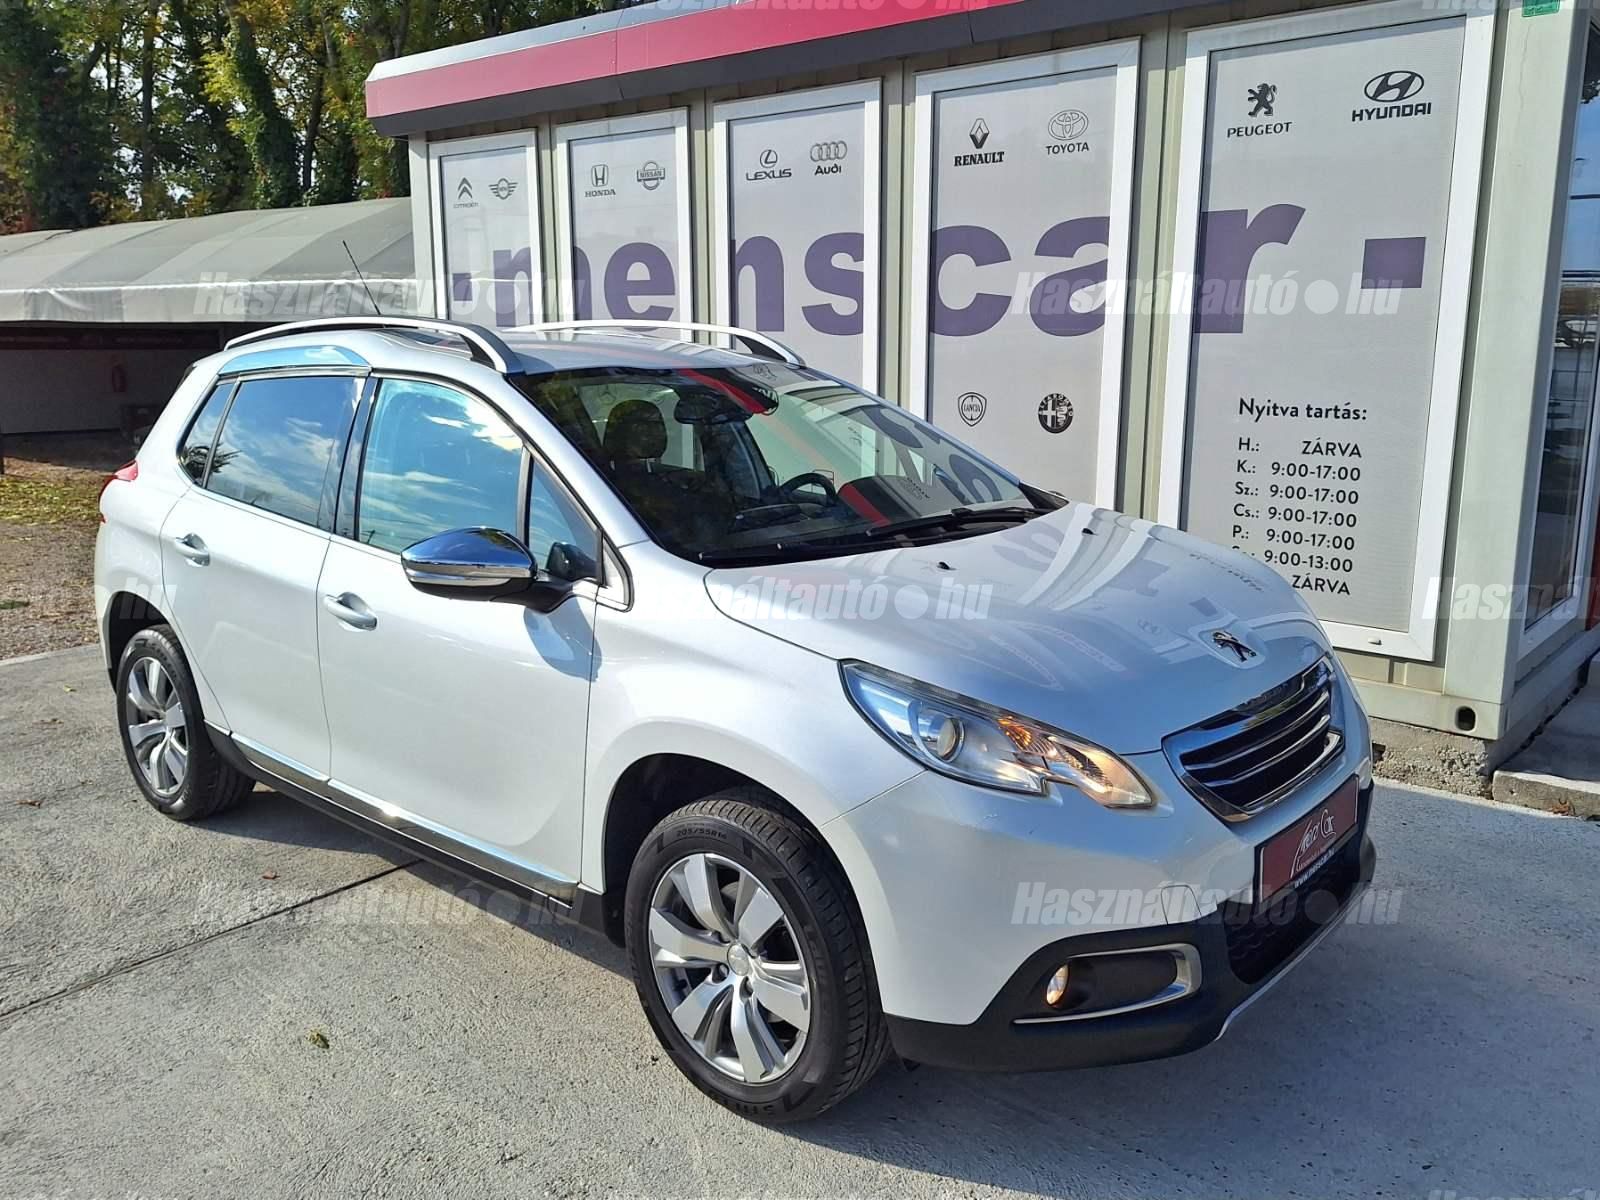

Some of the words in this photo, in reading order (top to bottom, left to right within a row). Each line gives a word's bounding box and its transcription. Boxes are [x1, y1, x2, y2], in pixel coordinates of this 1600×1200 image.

[1351, 101, 1433, 122] HYUNDAI
[1227, 121, 1293, 138] PEUGEOT
[954, 151, 1005, 167] RENAULT
[1046, 142, 1090, 155] TOYOTA
[639, 170, 662, 178] NISSAN
[745, 168, 792, 181] LEXUS
[814, 163, 842, 176] Audi
[584, 188, 616, 198] HONDA
[1239, 397, 1299, 423] Nyitva
[1305, 402, 1367, 420] tartás:
[1238, 437, 1260, 452] H.:
[1301, 437, 1362, 458] ZÁRVA
[1236, 459, 1256, 474] K.:
[1271, 461, 1361, 481] 9:00-17:00
[1235, 481, 1259, 496] Sz.:
[1269, 484, 1359, 504] 9:00-17:00
[1233, 503, 1260, 518] Cs.:
[1268, 506, 1357, 528] 9:00-17:00
[1232, 525, 1249, 539] P.:
[1266, 528, 1355, 551] 9:00-17:00
[1264, 549, 1353, 573] 9:00-13:00
[1291, 572, 1351, 596] ZÁRVA
